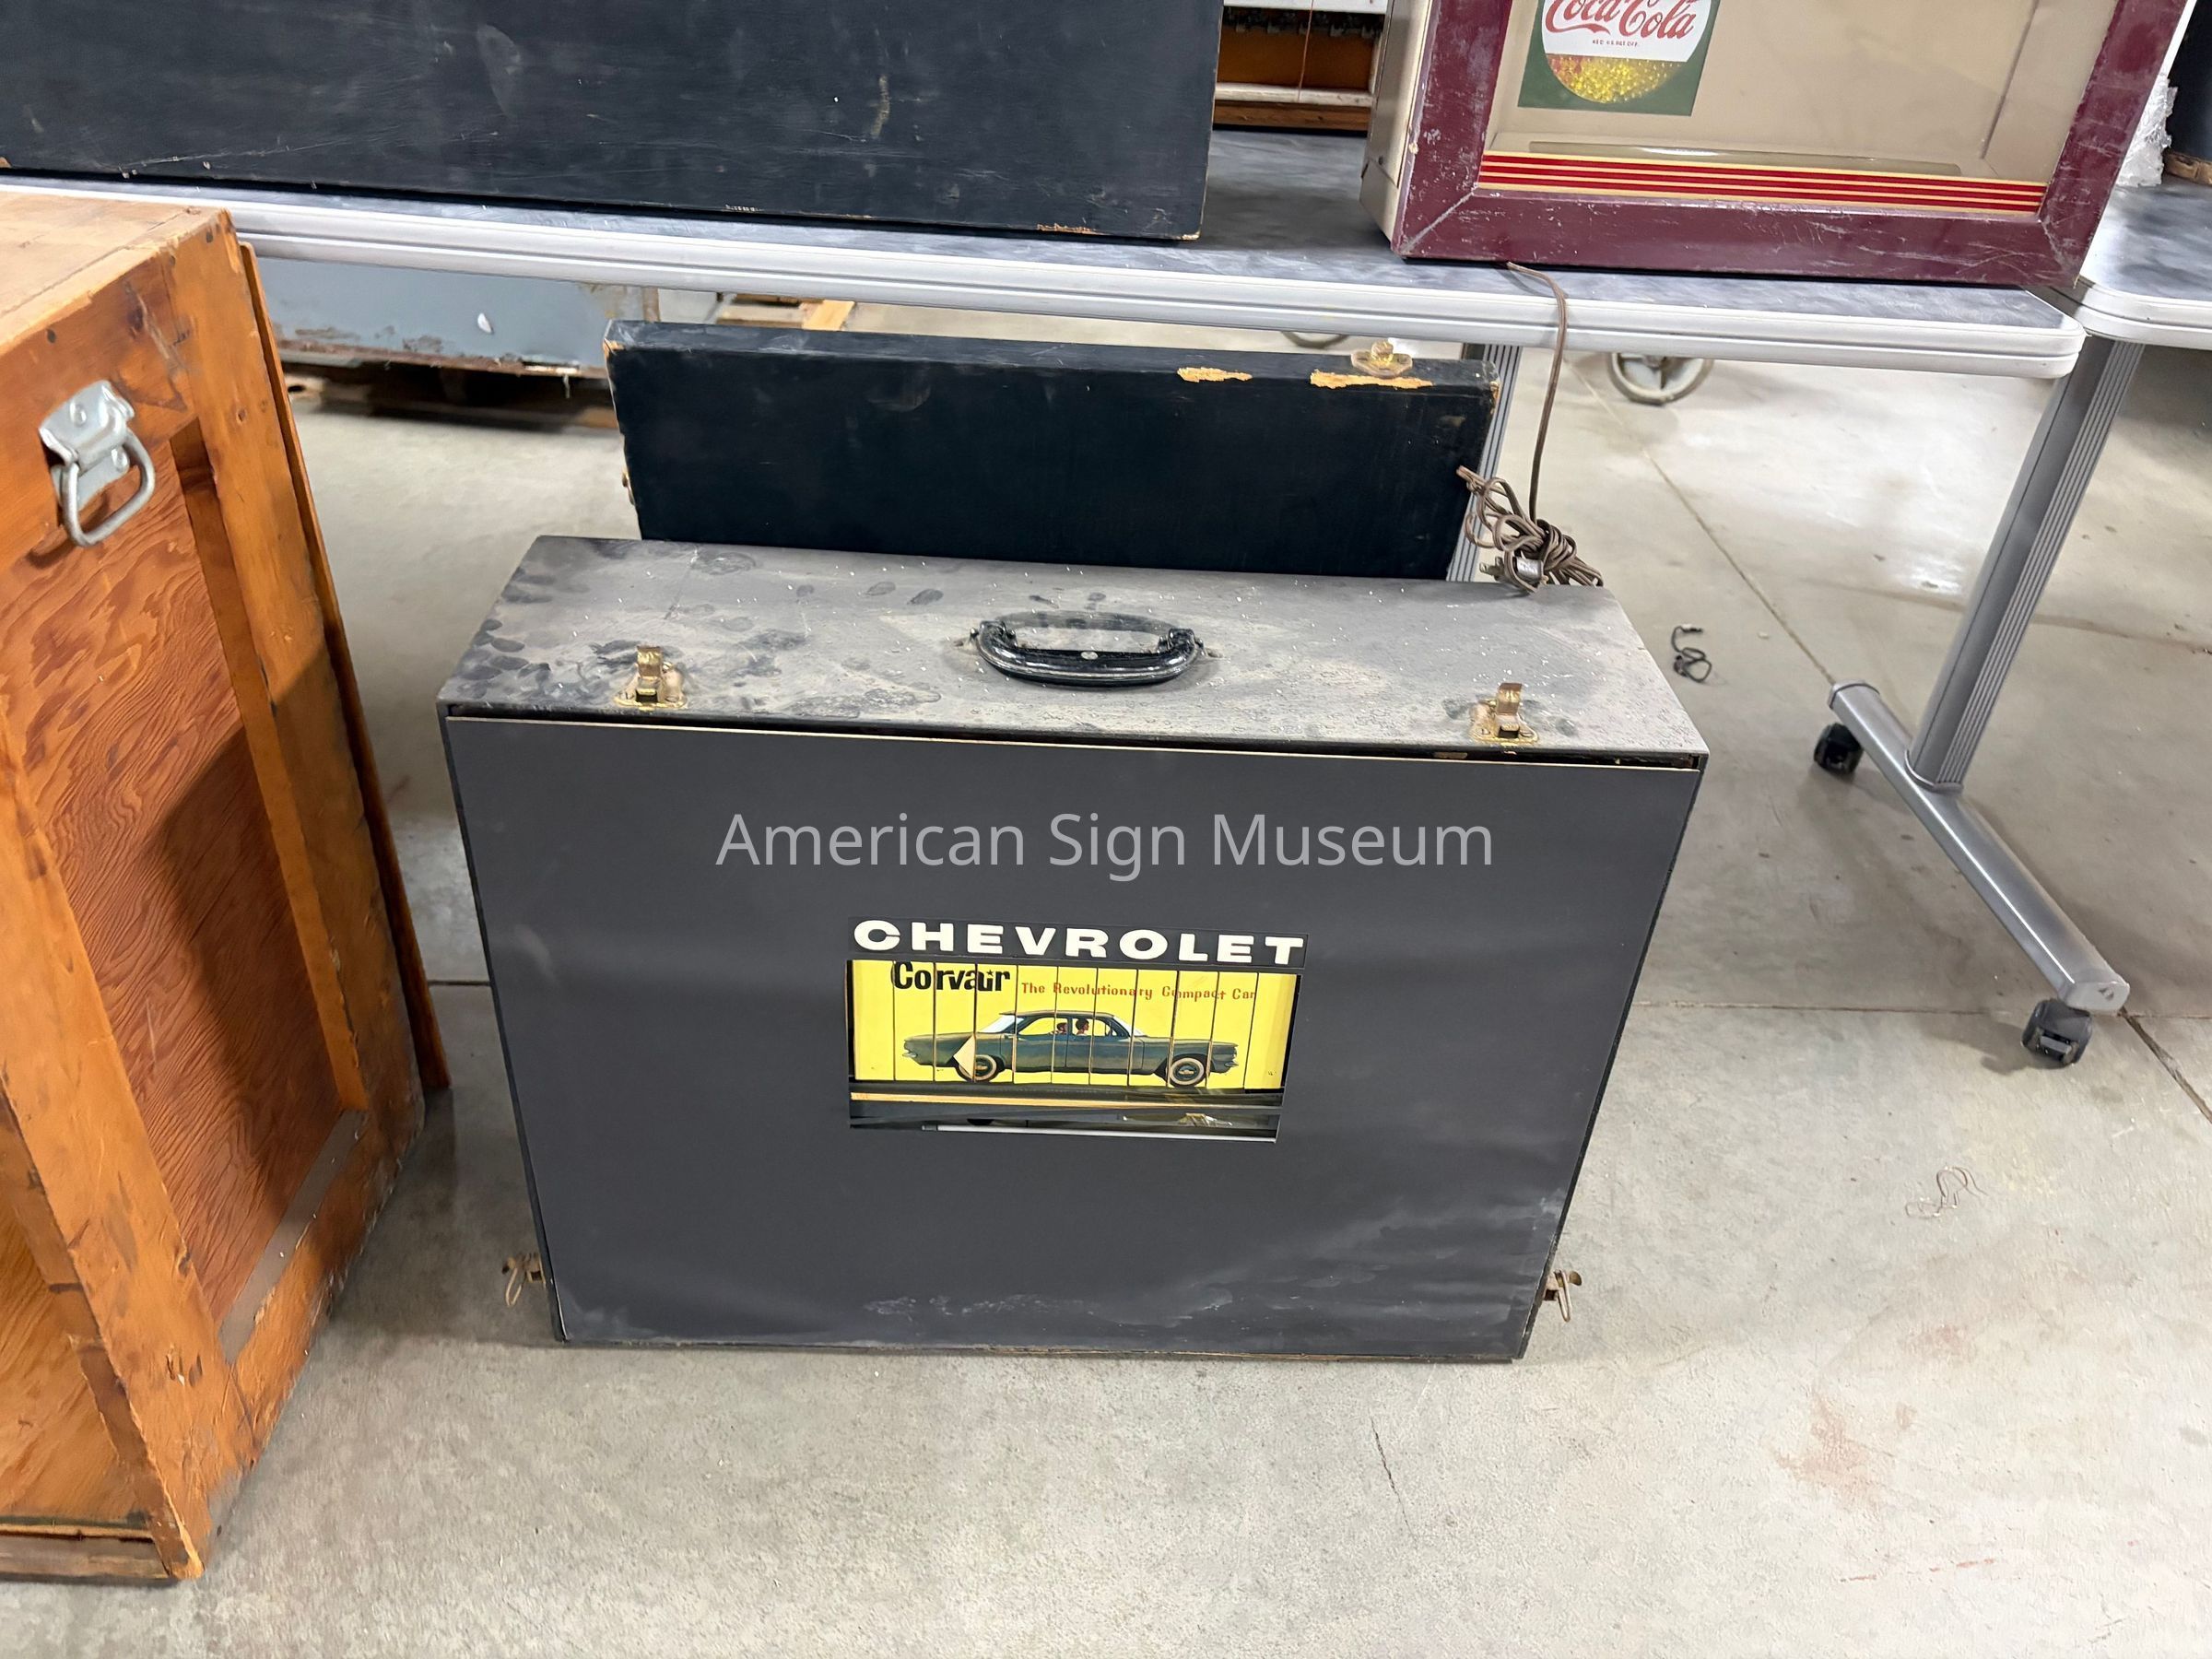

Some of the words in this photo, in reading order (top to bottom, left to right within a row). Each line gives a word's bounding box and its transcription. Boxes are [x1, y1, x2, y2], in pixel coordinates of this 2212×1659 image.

[1546, 0, 1697, 40] CocaCola
[853, 919, 1305, 966] CHEVROLET
[890, 961, 1011, 993] Corvair
[1021, 982, 1045, 995] The
[1053, 982, 1153, 1000] Revolutionary
[1161, 986, 1227, 1002] Compact
[1232, 988, 1256, 1000] Car
